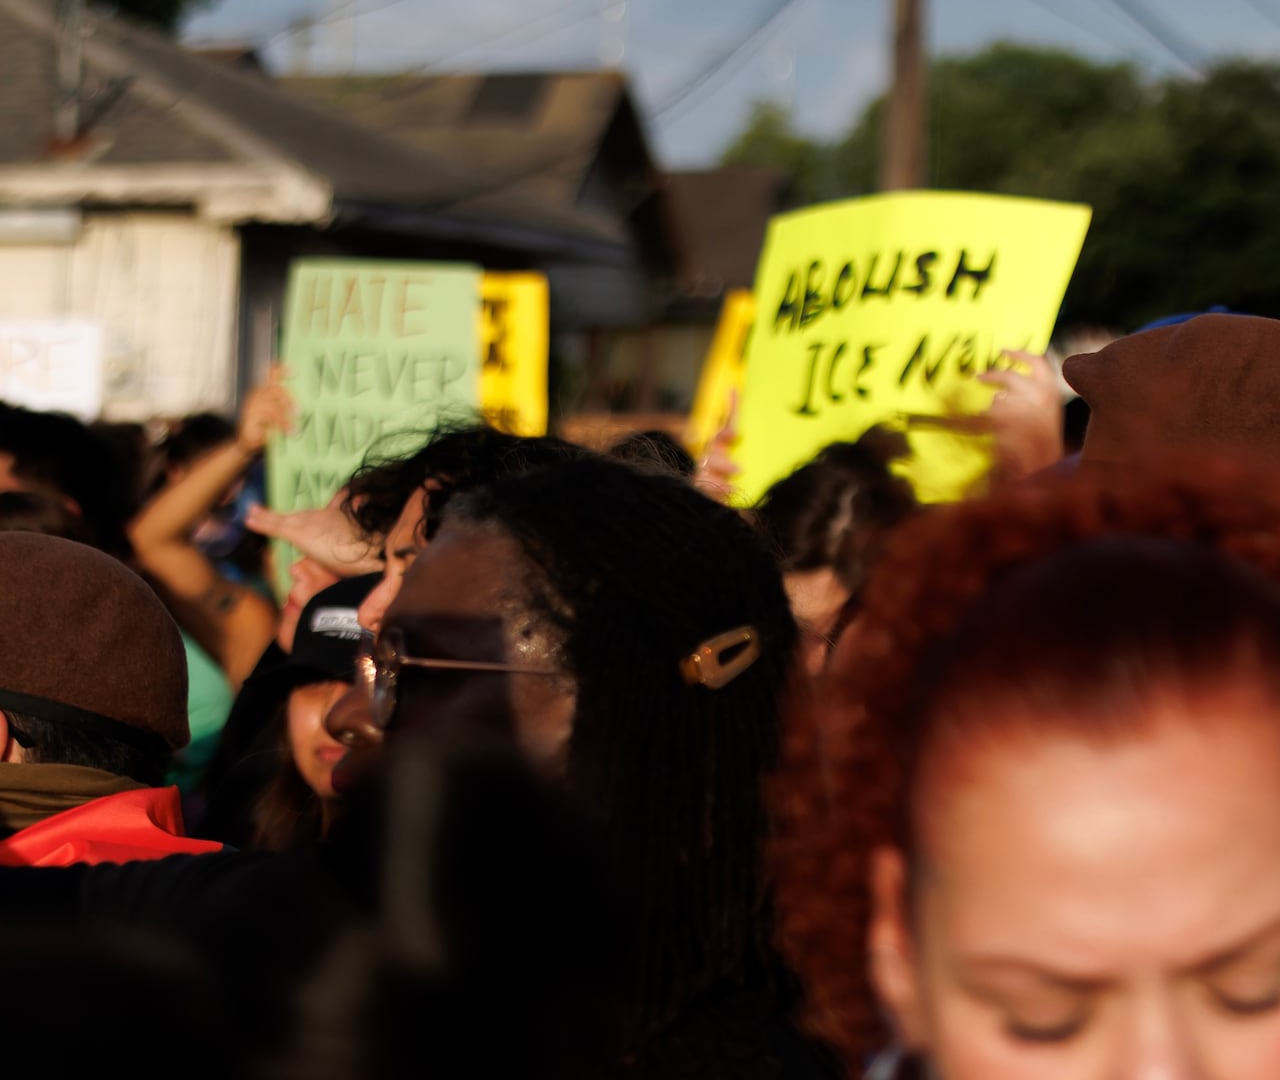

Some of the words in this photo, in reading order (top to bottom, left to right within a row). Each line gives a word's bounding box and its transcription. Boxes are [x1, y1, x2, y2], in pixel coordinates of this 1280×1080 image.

[302, 276, 435, 339] HATE
[772, 247, 998, 333] ABOLISH
[788, 341, 888, 417] ICE
